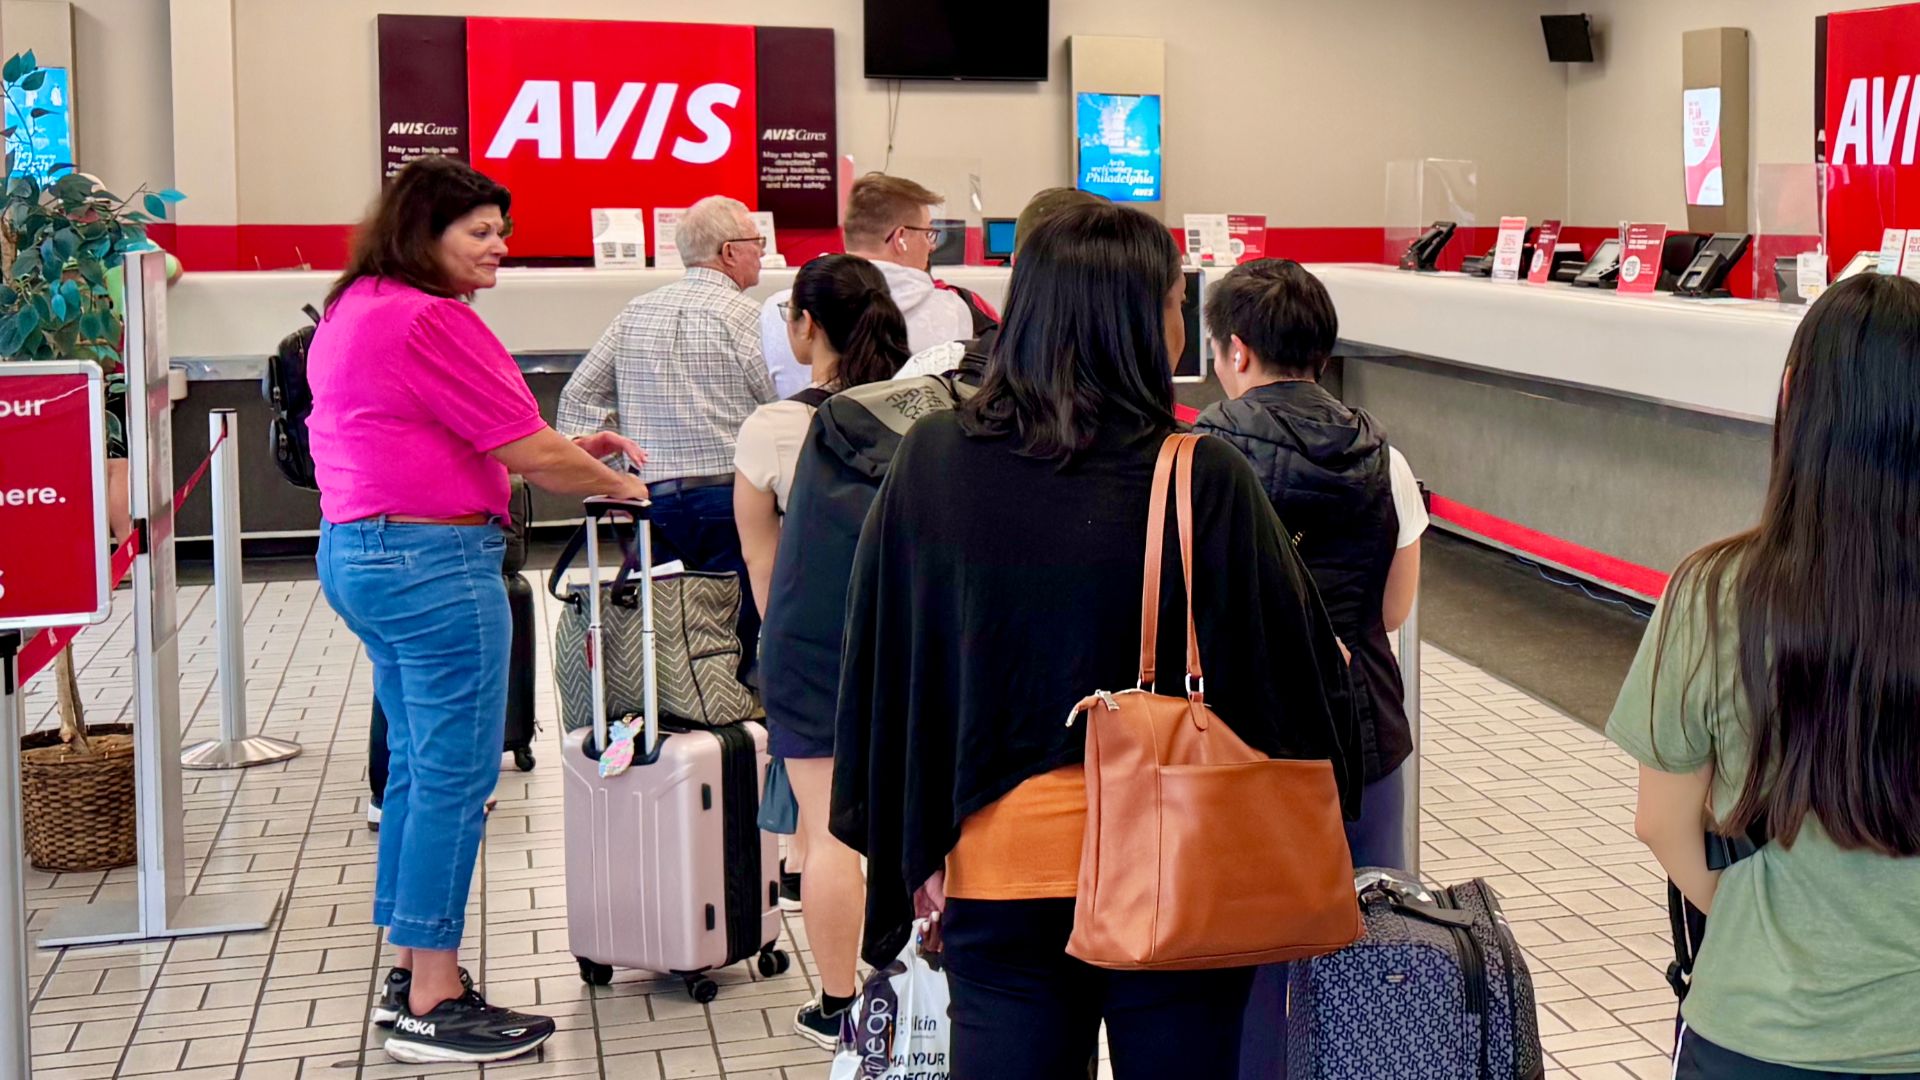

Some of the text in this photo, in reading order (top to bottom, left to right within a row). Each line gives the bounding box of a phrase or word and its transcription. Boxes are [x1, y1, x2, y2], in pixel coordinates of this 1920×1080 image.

[485, 80, 741, 164] AVIS
[388, 145, 406, 155] May
[422, 146, 440, 155] help
[1085, 172, 1154, 186] Philadelphia
[0, 487, 66, 507] ere.
[396, 1014, 436, 1037] HOKA
